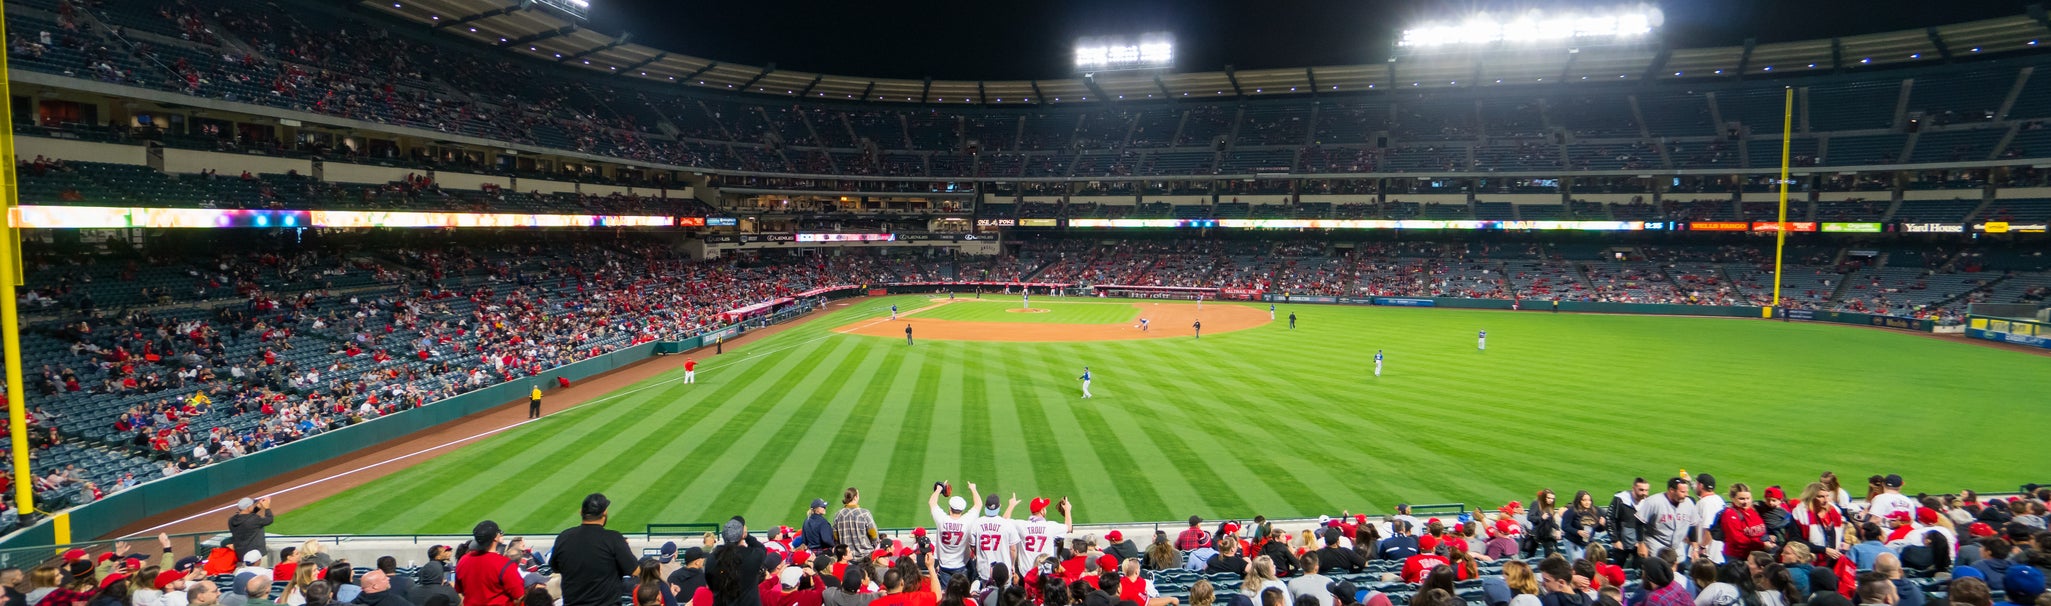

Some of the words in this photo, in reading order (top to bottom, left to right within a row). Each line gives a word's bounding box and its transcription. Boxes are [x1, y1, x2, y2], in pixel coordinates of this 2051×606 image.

[1905, 223, 1929, 233] Yard
[1930, 223, 1963, 233] House
[944, 522, 964, 532] TROUT
[980, 523, 1001, 533] TROUT
[1027, 526, 1046, 535] TROUT
[941, 531, 964, 546] 27
[980, 534, 1002, 552] 27
[1025, 535, 1047, 552] 27
